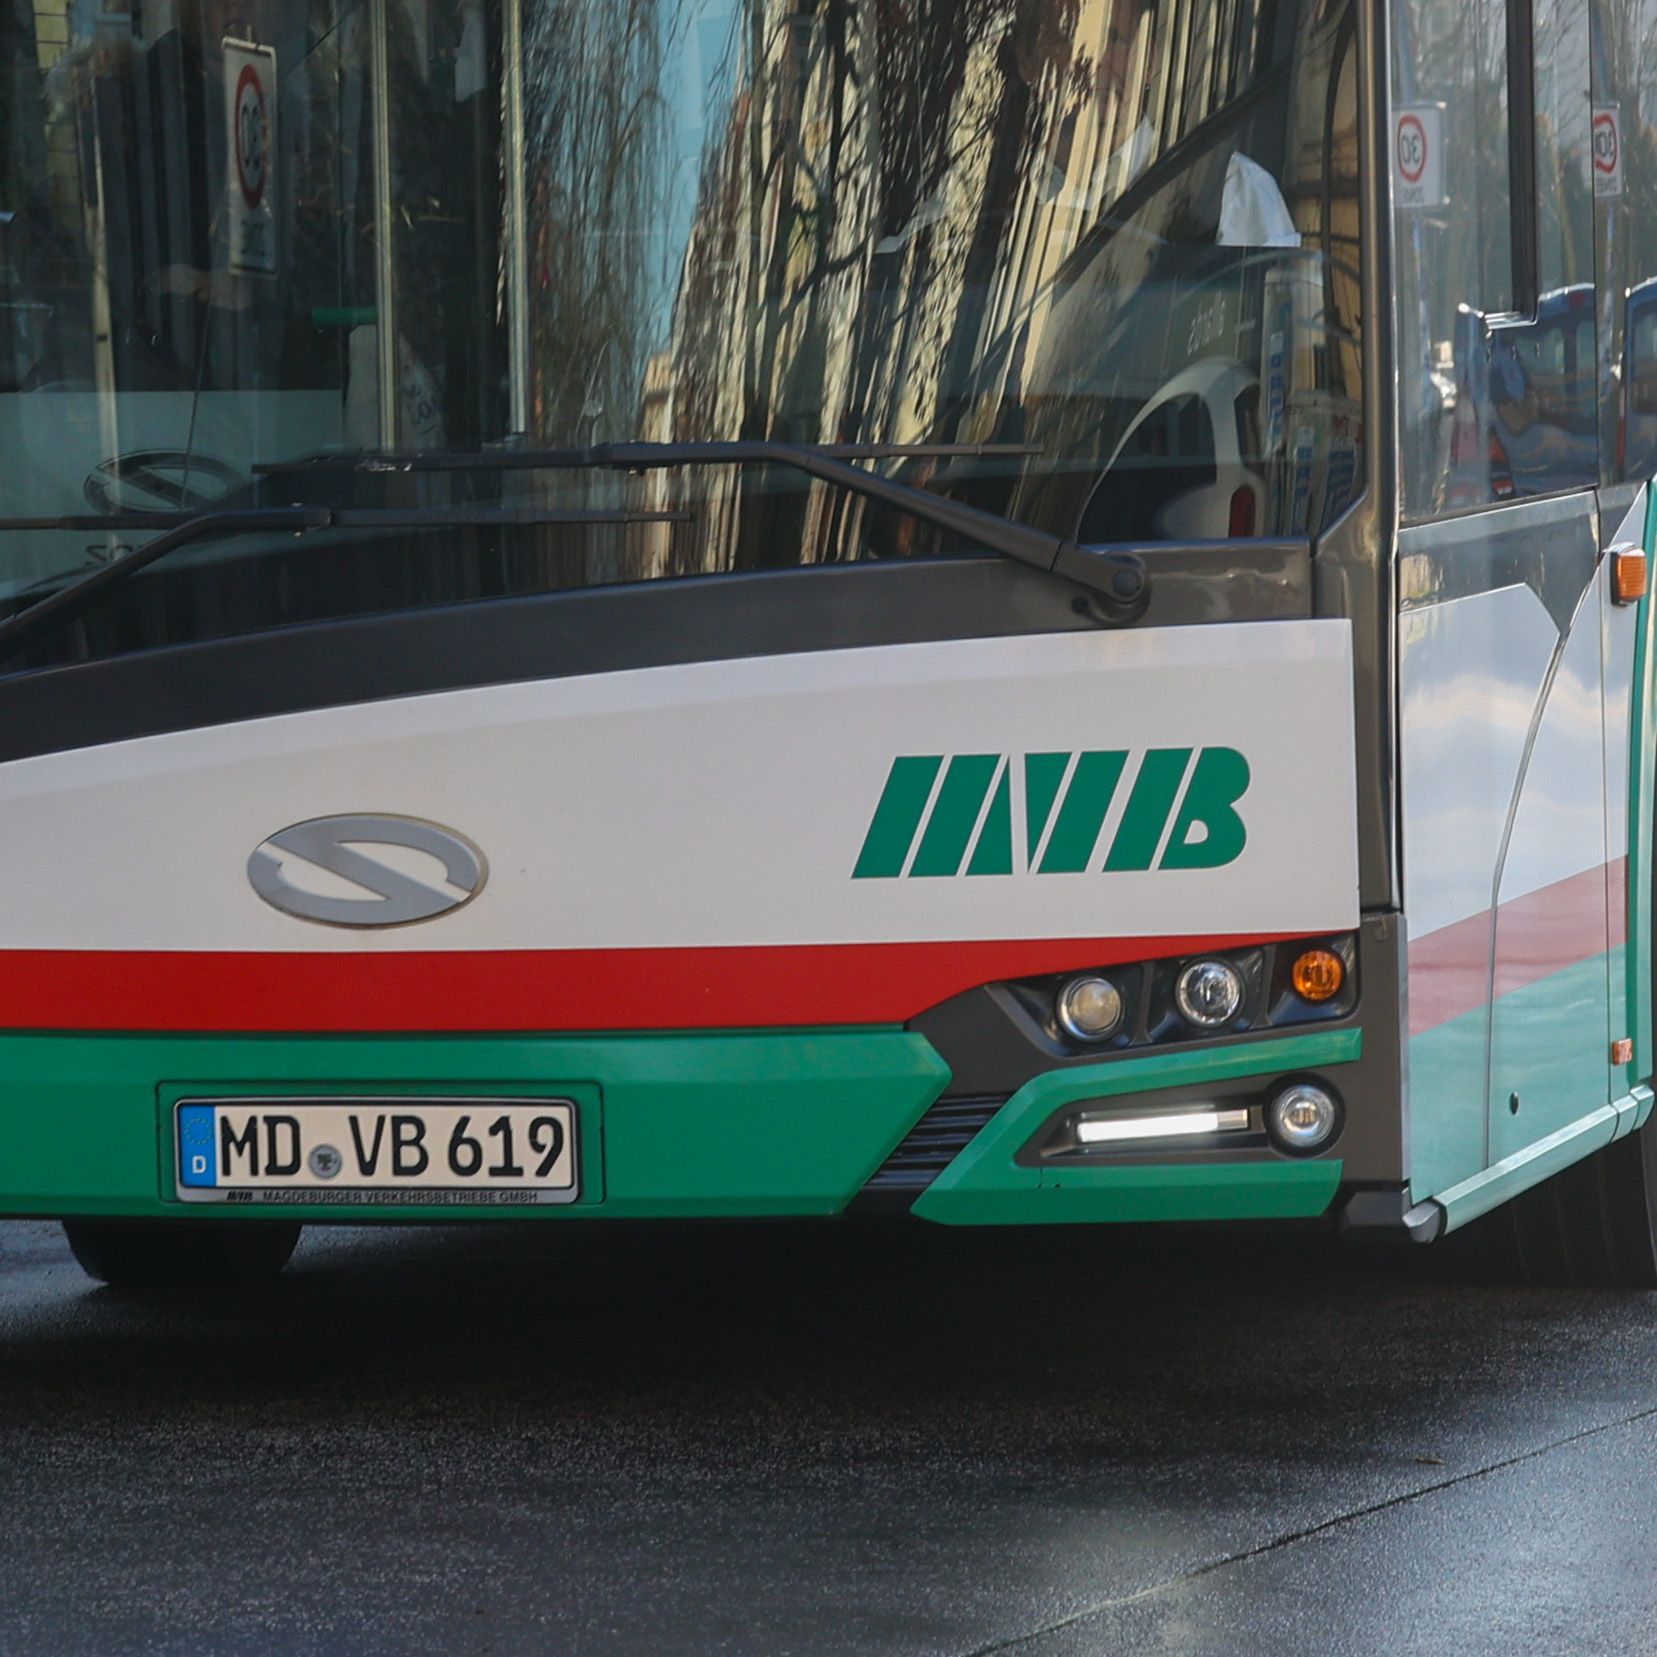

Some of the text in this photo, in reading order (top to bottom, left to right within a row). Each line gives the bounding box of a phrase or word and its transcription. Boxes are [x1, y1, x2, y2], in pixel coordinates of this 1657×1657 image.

[192, 1155, 207, 1174] D
[220, 1114, 564, 1177] MD VB 619
